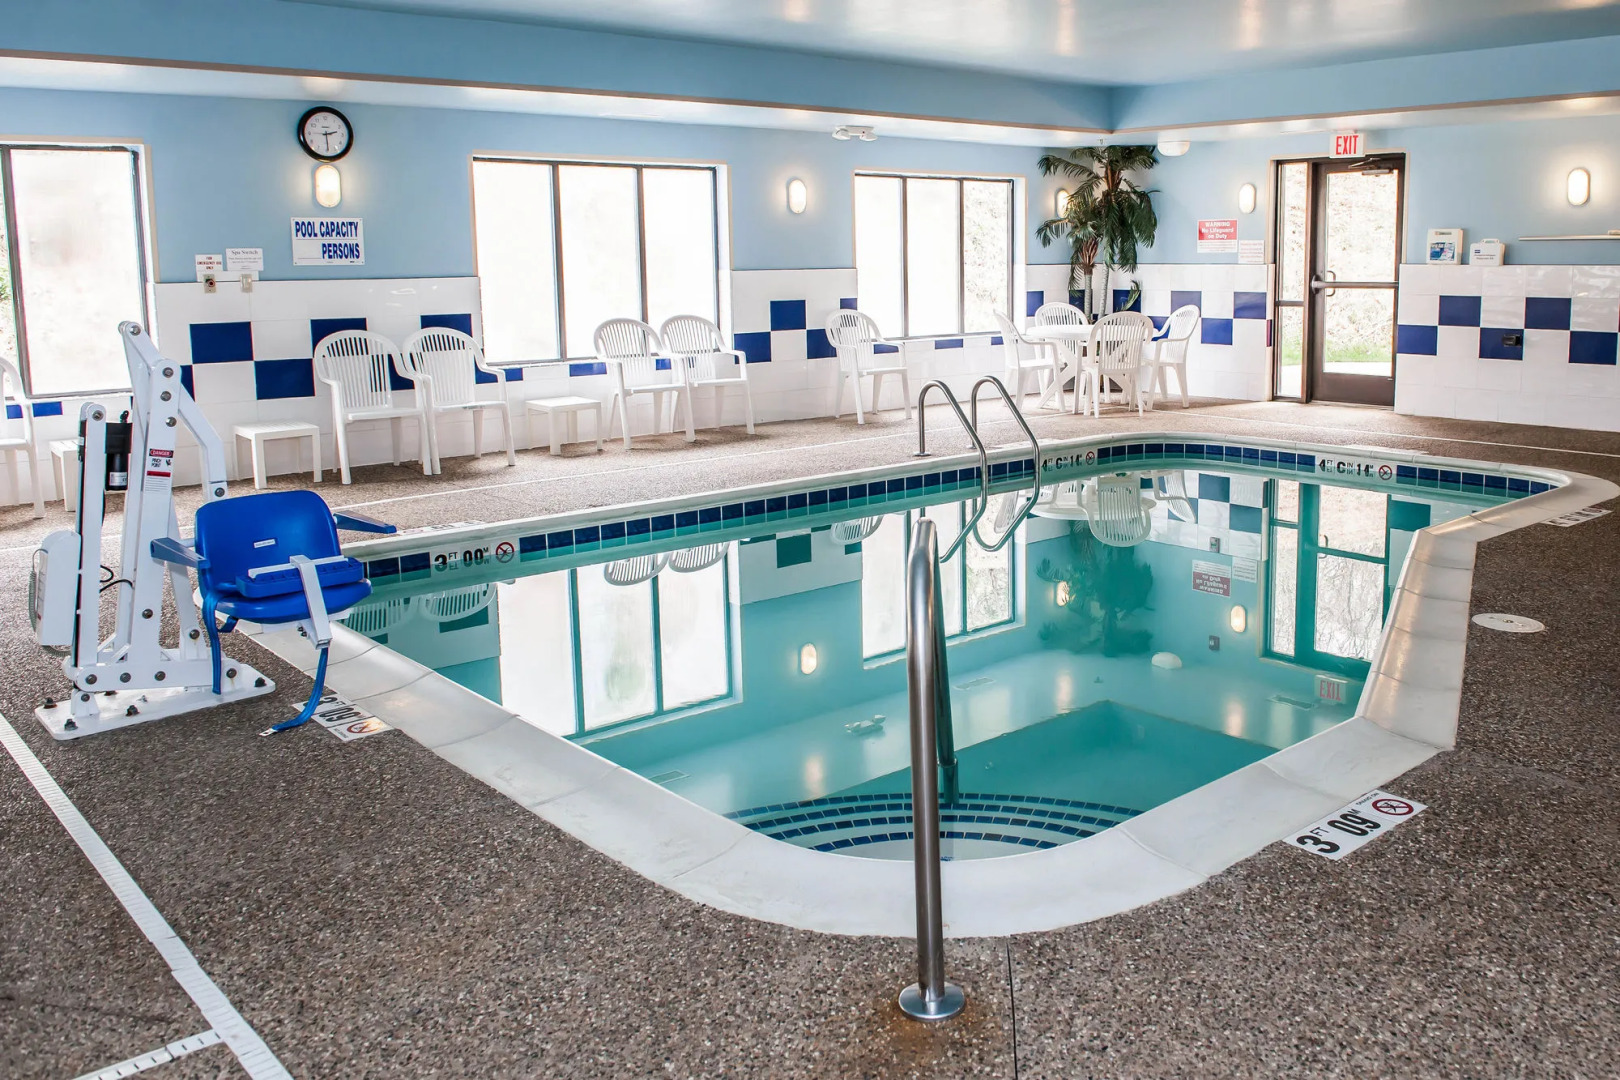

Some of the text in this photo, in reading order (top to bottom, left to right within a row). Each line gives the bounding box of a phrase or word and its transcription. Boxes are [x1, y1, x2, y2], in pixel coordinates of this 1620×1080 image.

[1336, 135, 1359, 155] EXIT
[295, 221, 359, 238] POOL CAPACITY
[321, 242, 361, 260] PERSONS
[448, 551, 458, 560] FT
[1309, 826, 1330, 837] FT
[1296, 835, 1340, 854] 3
